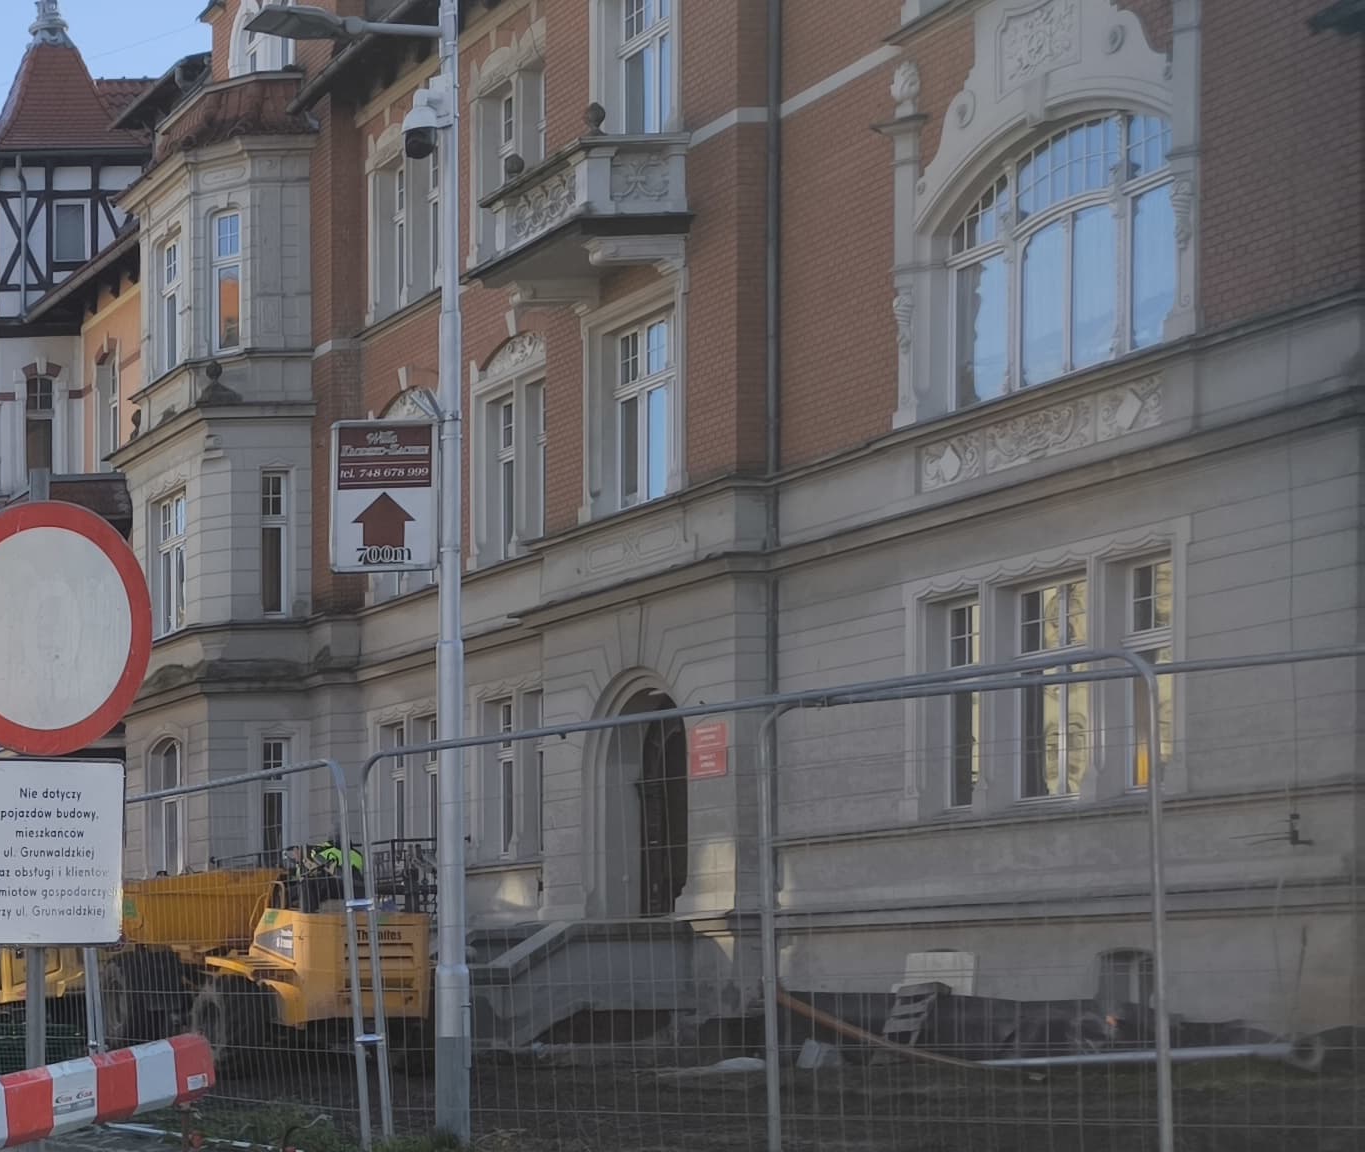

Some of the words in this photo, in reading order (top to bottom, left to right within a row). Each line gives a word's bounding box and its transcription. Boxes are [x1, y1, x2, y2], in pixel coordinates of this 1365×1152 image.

[359, 468, 381, 478] 748
[407, 466, 429, 477] 999
[356, 546, 412, 564] 700m
[19, 788, 38, 799] Nie
[42, 788, 82, 801] dotyczy
[3, 847, 16, 858] ul.
[20, 846, 95, 860] Grunwaldzkiej
[14, 866, 54, 880] obsługi
[15, 906, 28, 917] ul.
[31, 905, 106, 918] Grunwaldzkiej
